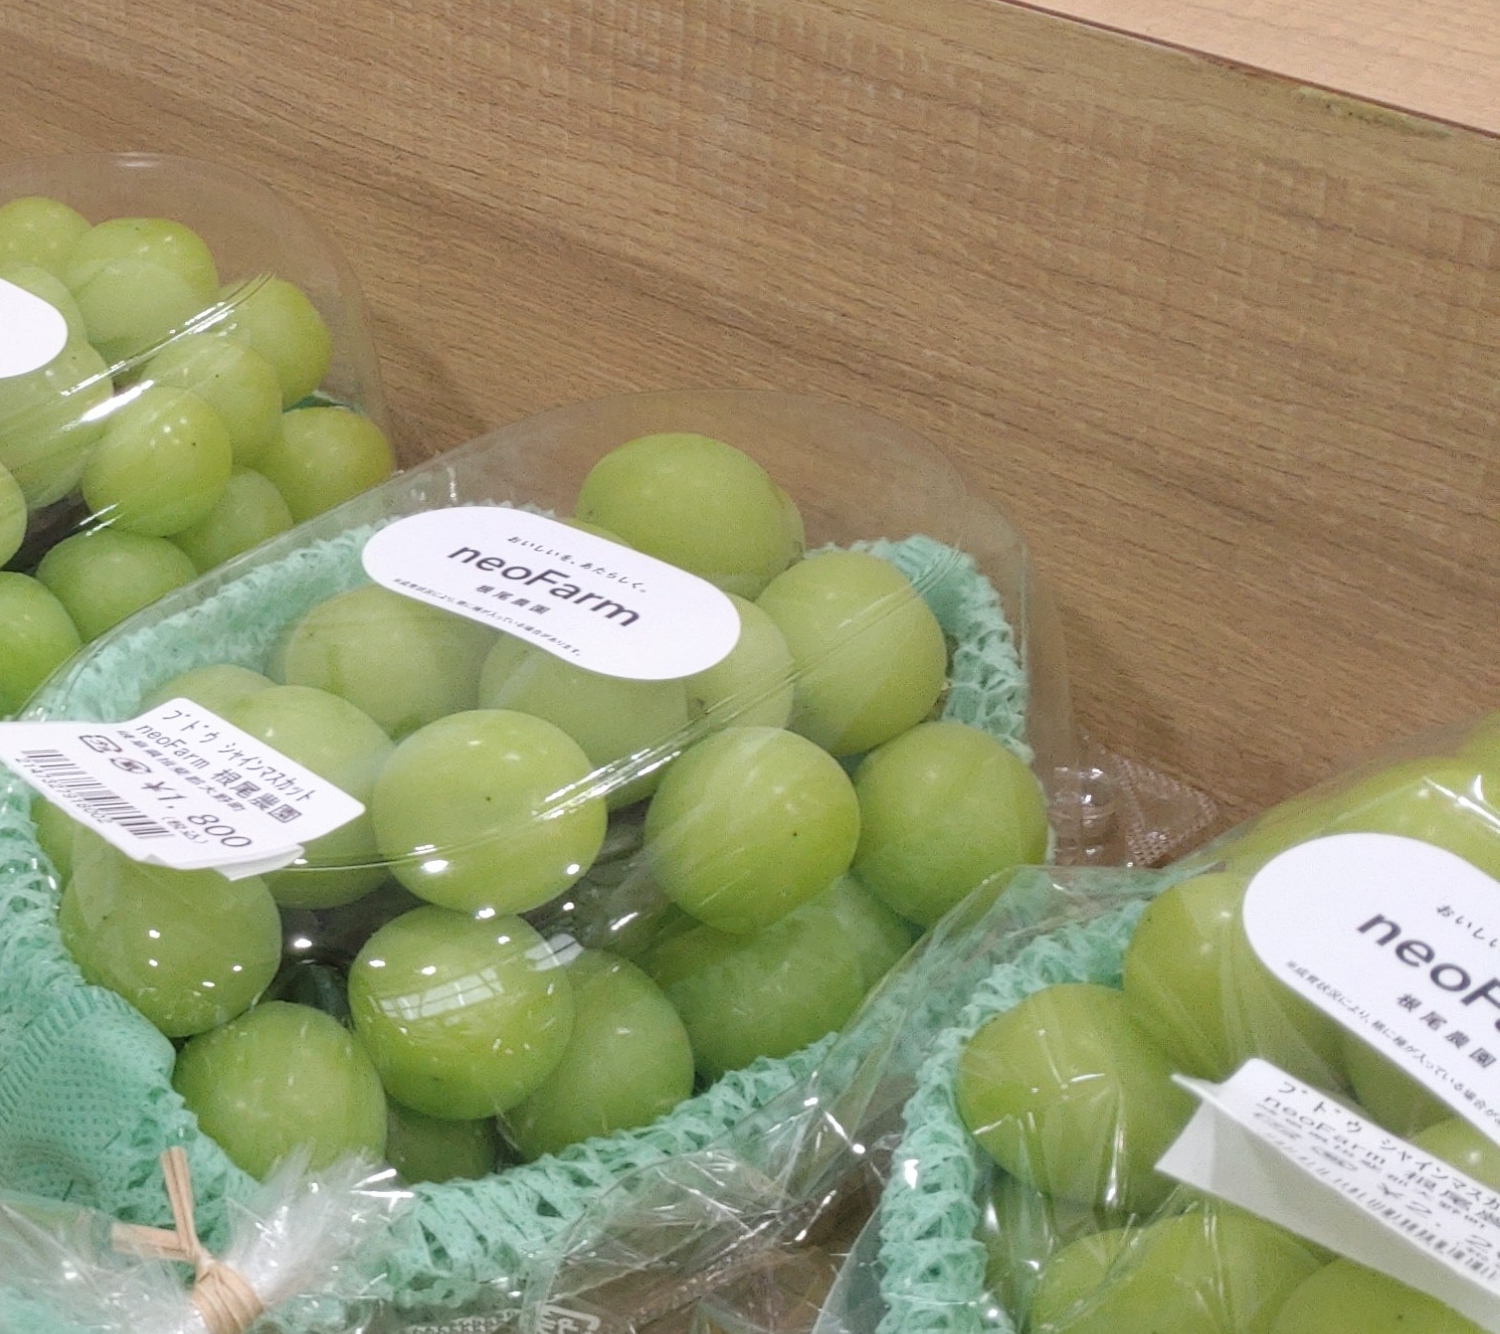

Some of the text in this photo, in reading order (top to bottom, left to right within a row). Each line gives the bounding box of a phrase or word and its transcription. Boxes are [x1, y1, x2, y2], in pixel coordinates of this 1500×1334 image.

[447, 546, 641, 628] neoFarm
[507, 535, 649, 594] おいしいを、あたらしく。
[135, 724, 303, 824] neoFarm 根尾農園
[163, 709, 317, 803] ブドウ シャインマスカット
[141, 780, 253, 848] ¥1,800
[1356, 913, 1500, 1038] neoF
[1396, 992, 1498, 1069] 根尾農園
[1263, 1096, 1387, 1165] neoFarm
[1278, 1081, 1362, 1134] ブドウ
